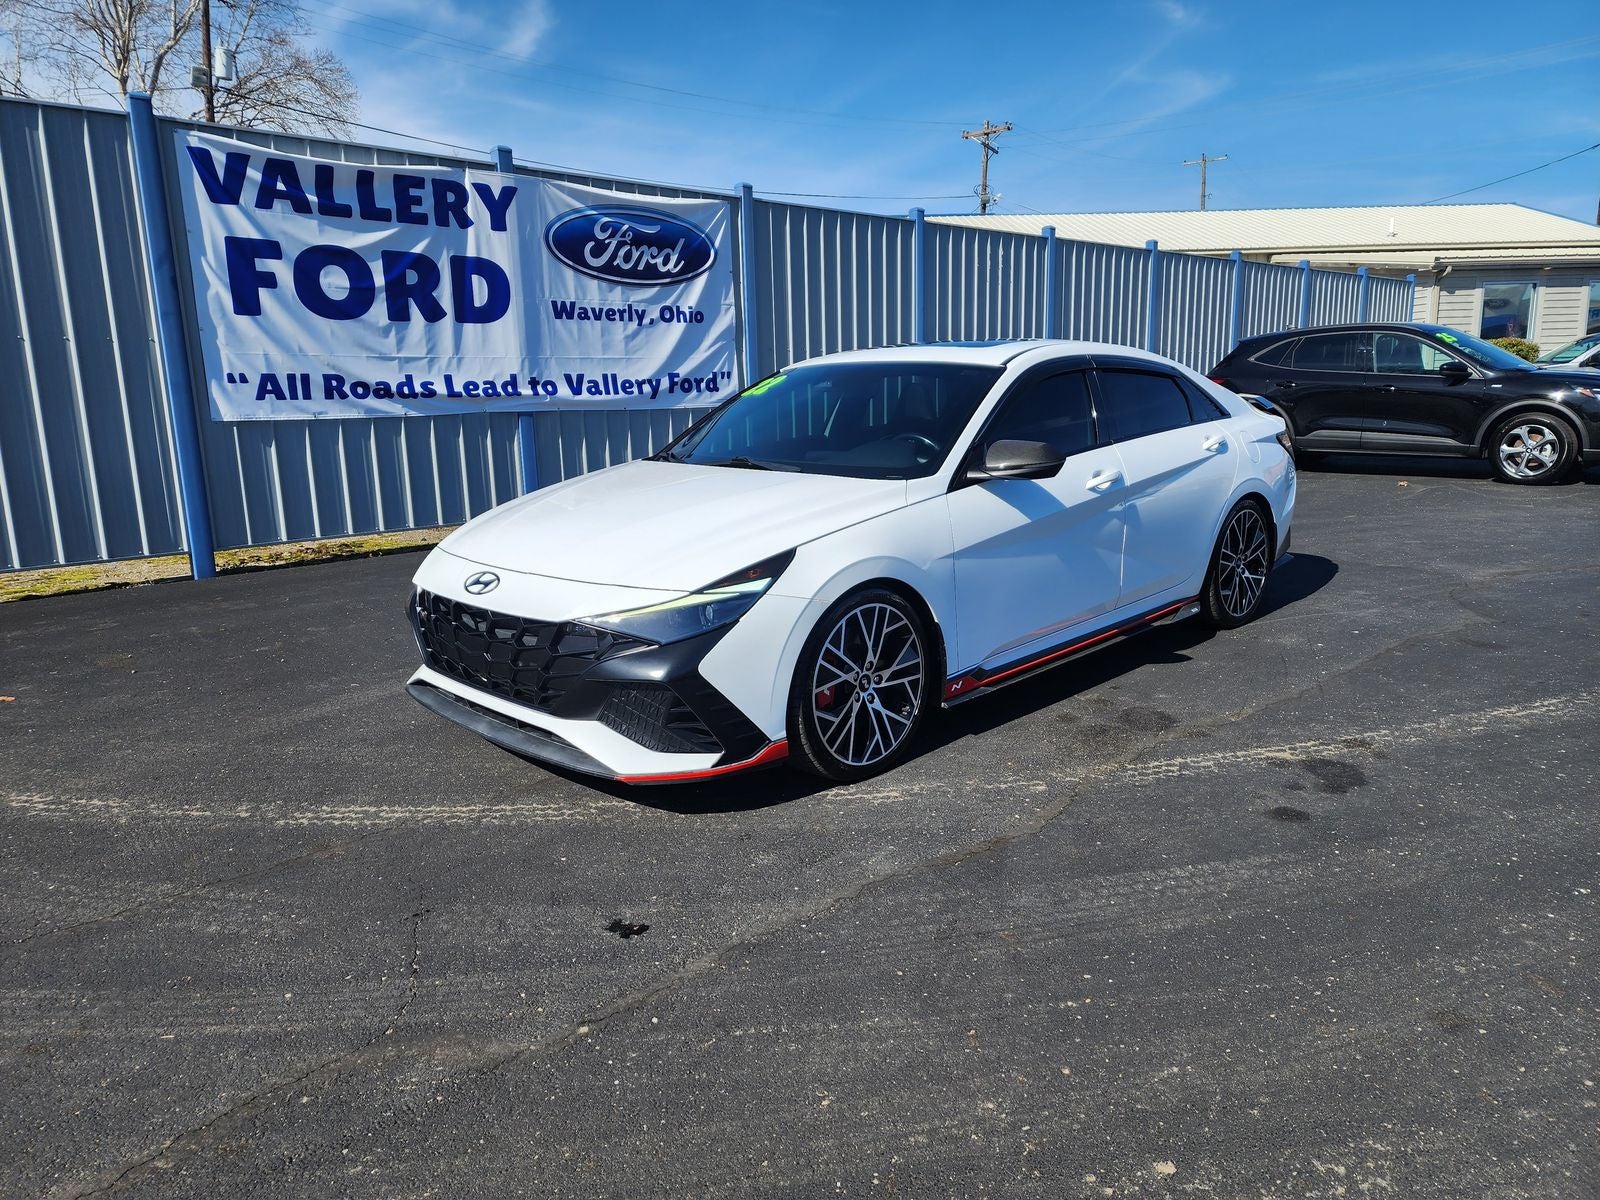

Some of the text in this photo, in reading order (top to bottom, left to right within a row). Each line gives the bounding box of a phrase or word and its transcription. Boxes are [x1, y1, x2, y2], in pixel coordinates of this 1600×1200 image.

[186, 145, 518, 232] VALLERY
[584, 216, 686, 273] Ford
[224, 236, 511, 324] FORD
[551, 300, 705, 327] Waverly, Ohio
[322, 373, 438, 400] Roads
[443, 373, 522, 398] Lead
[528, 376, 559, 397] to
[563, 373, 661, 399] Vallery
[667, 371, 732, 394] Ford"
